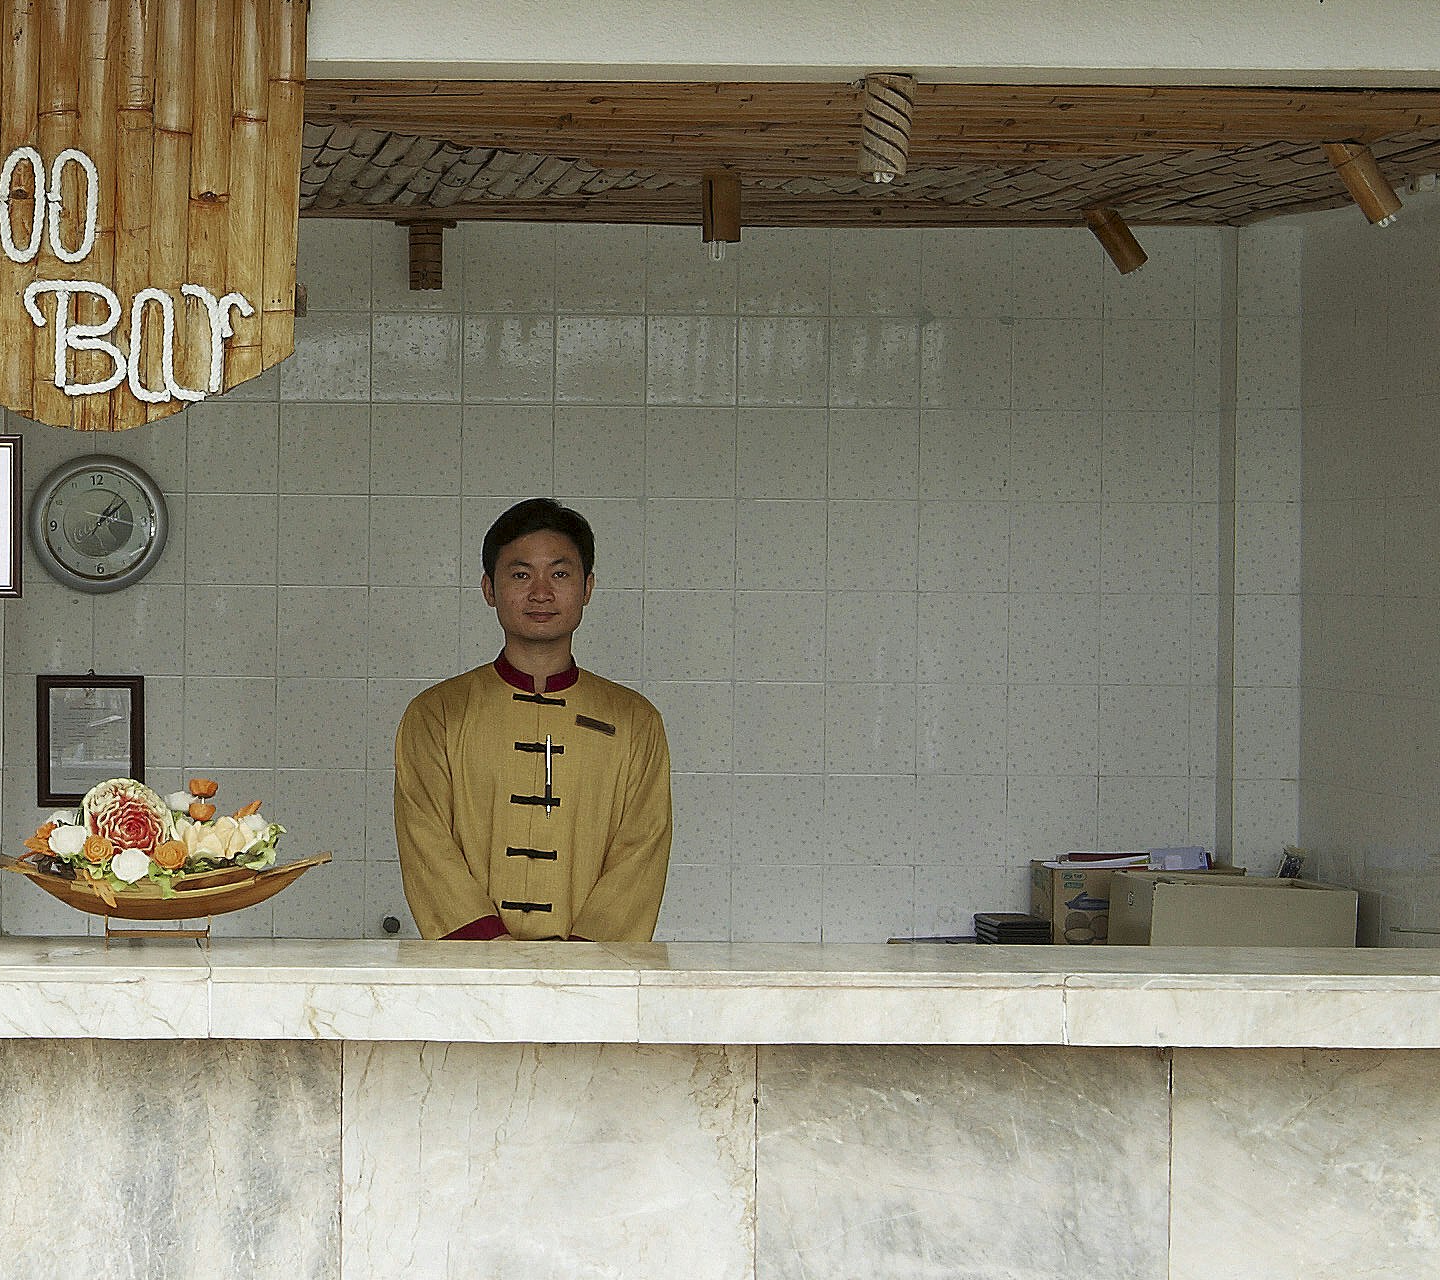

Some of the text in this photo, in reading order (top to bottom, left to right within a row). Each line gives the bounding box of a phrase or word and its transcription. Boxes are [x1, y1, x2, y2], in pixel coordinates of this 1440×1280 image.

[23, 279, 255, 405] Bar
[90, 474, 104, 486] 12
[49, 520, 58, 531] 9
[96, 563, 105, 574] 6
